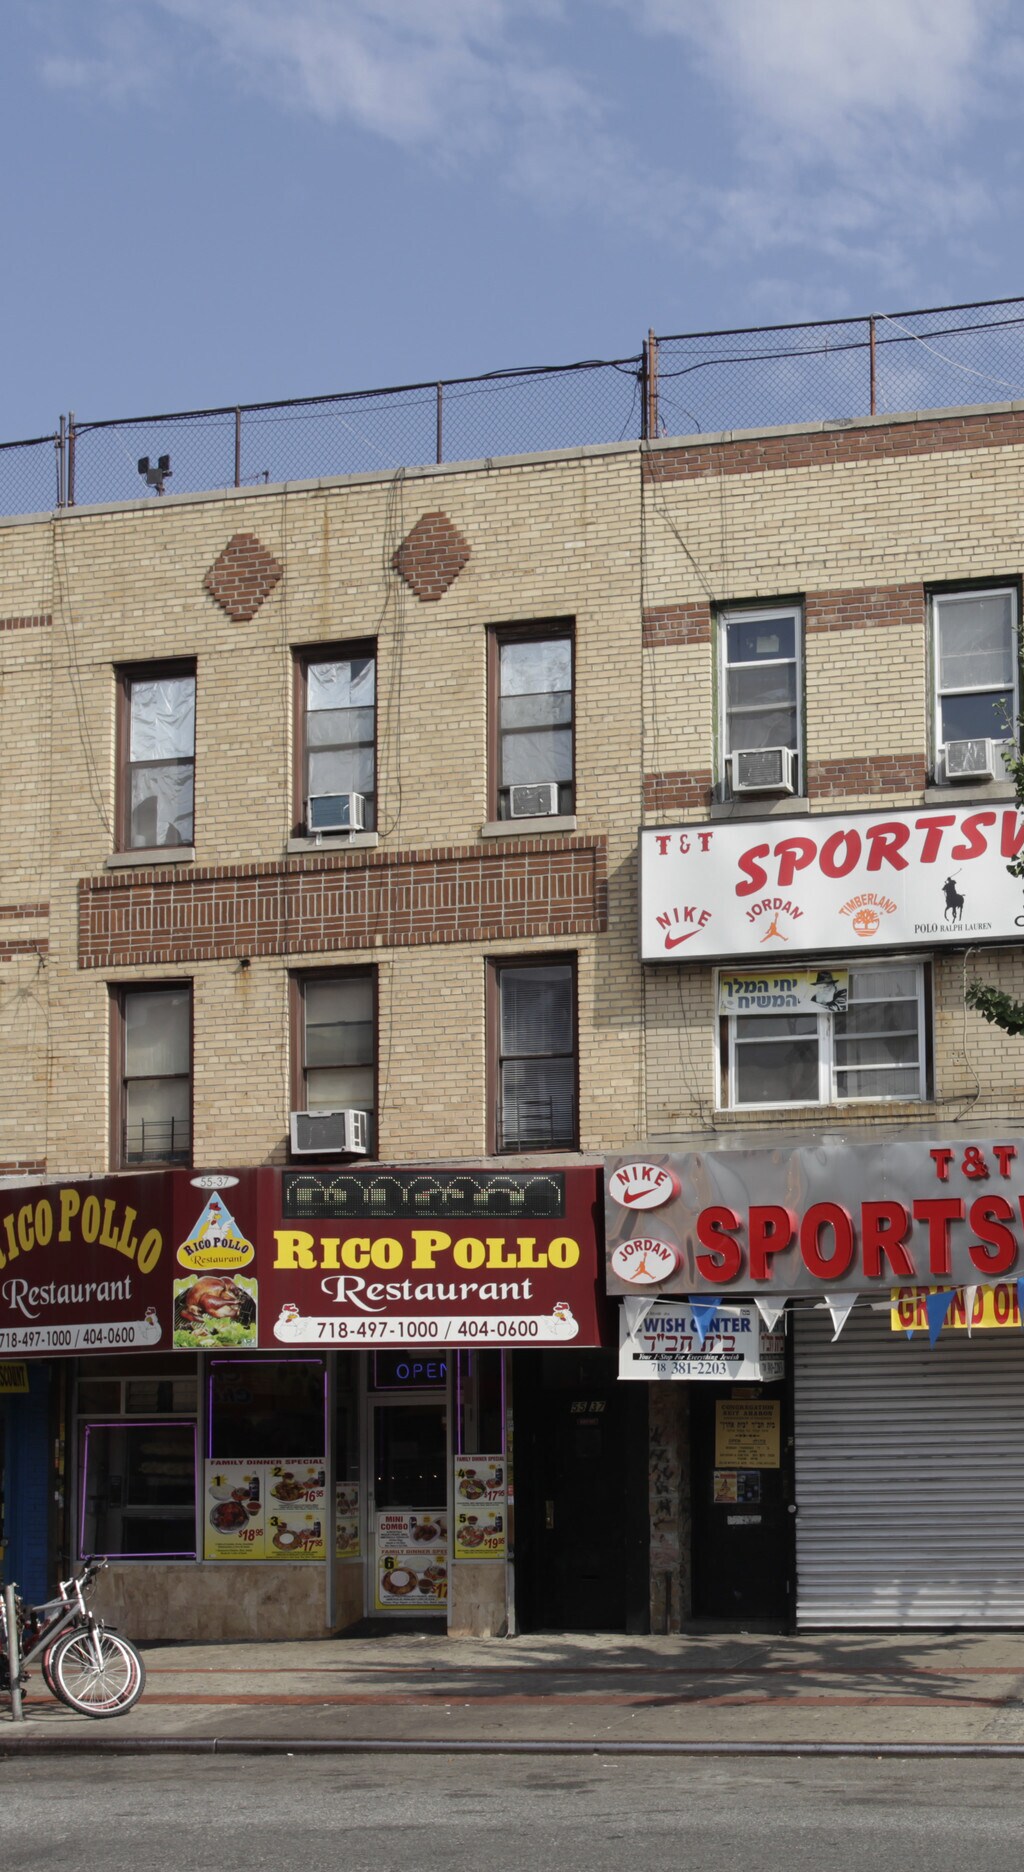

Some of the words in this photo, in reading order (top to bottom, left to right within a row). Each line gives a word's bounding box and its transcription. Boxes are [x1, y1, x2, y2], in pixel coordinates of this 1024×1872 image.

[745, 898, 805, 923] JORDAN
[838, 893, 899, 917] TIMBERLAND
[656, 906, 713, 929] NIKE
[914, 923, 938, 935] POLO
[940, 923, 963, 933] RALPH
[964, 922, 992, 932] LAUREN
[724, 978, 769, 997] המלך
[774, 978, 798, 992] יחי
[200, 1176, 230, 1188] 55-37
[616, 1166, 668, 1187] NIKE
[0, 1199, 53, 1270] ICO
[58, 1188, 163, 1274] POLLO
[183, 1239, 212, 1257] RICO
[213, 1236, 250, 1255] POLLO
[273, 1230, 404, 1270] RICO
[411, 1230, 580, 1270] POLLO
[619, 1239, 672, 1262] JORDAN
[190, 1254, 243, 1267] Restaurant
[2, 1274, 132, 1319] Restaurant
[321, 1275, 533, 1312] Restaurant
[0, 1330, 72, 1349] 718-497-1000
[83, 1326, 136, 1344] 404-0600
[317, 1321, 439, 1339] 718-497-1000
[457, 1320, 539, 1337] 404-0600
[638, 1353, 652, 1361] Your
[674, 1353, 686, 1361] For
[687, 1353, 718, 1361] Everything
[719, 1353, 740, 1361] Jewish
[651, 1362, 667, 1373] 718
[671, 1361, 727, 1375] 381-2203
[273, 1467, 282, 1477] 2
[458, 1469, 465, 1478] 4
[214, 1476, 221, 1486] 1
[270, 1516, 279, 1526] 3
[460, 1513, 467, 1523] 5
[380, 1523, 408, 1531] COMBO
[384, 1556, 395, 1569] 6
